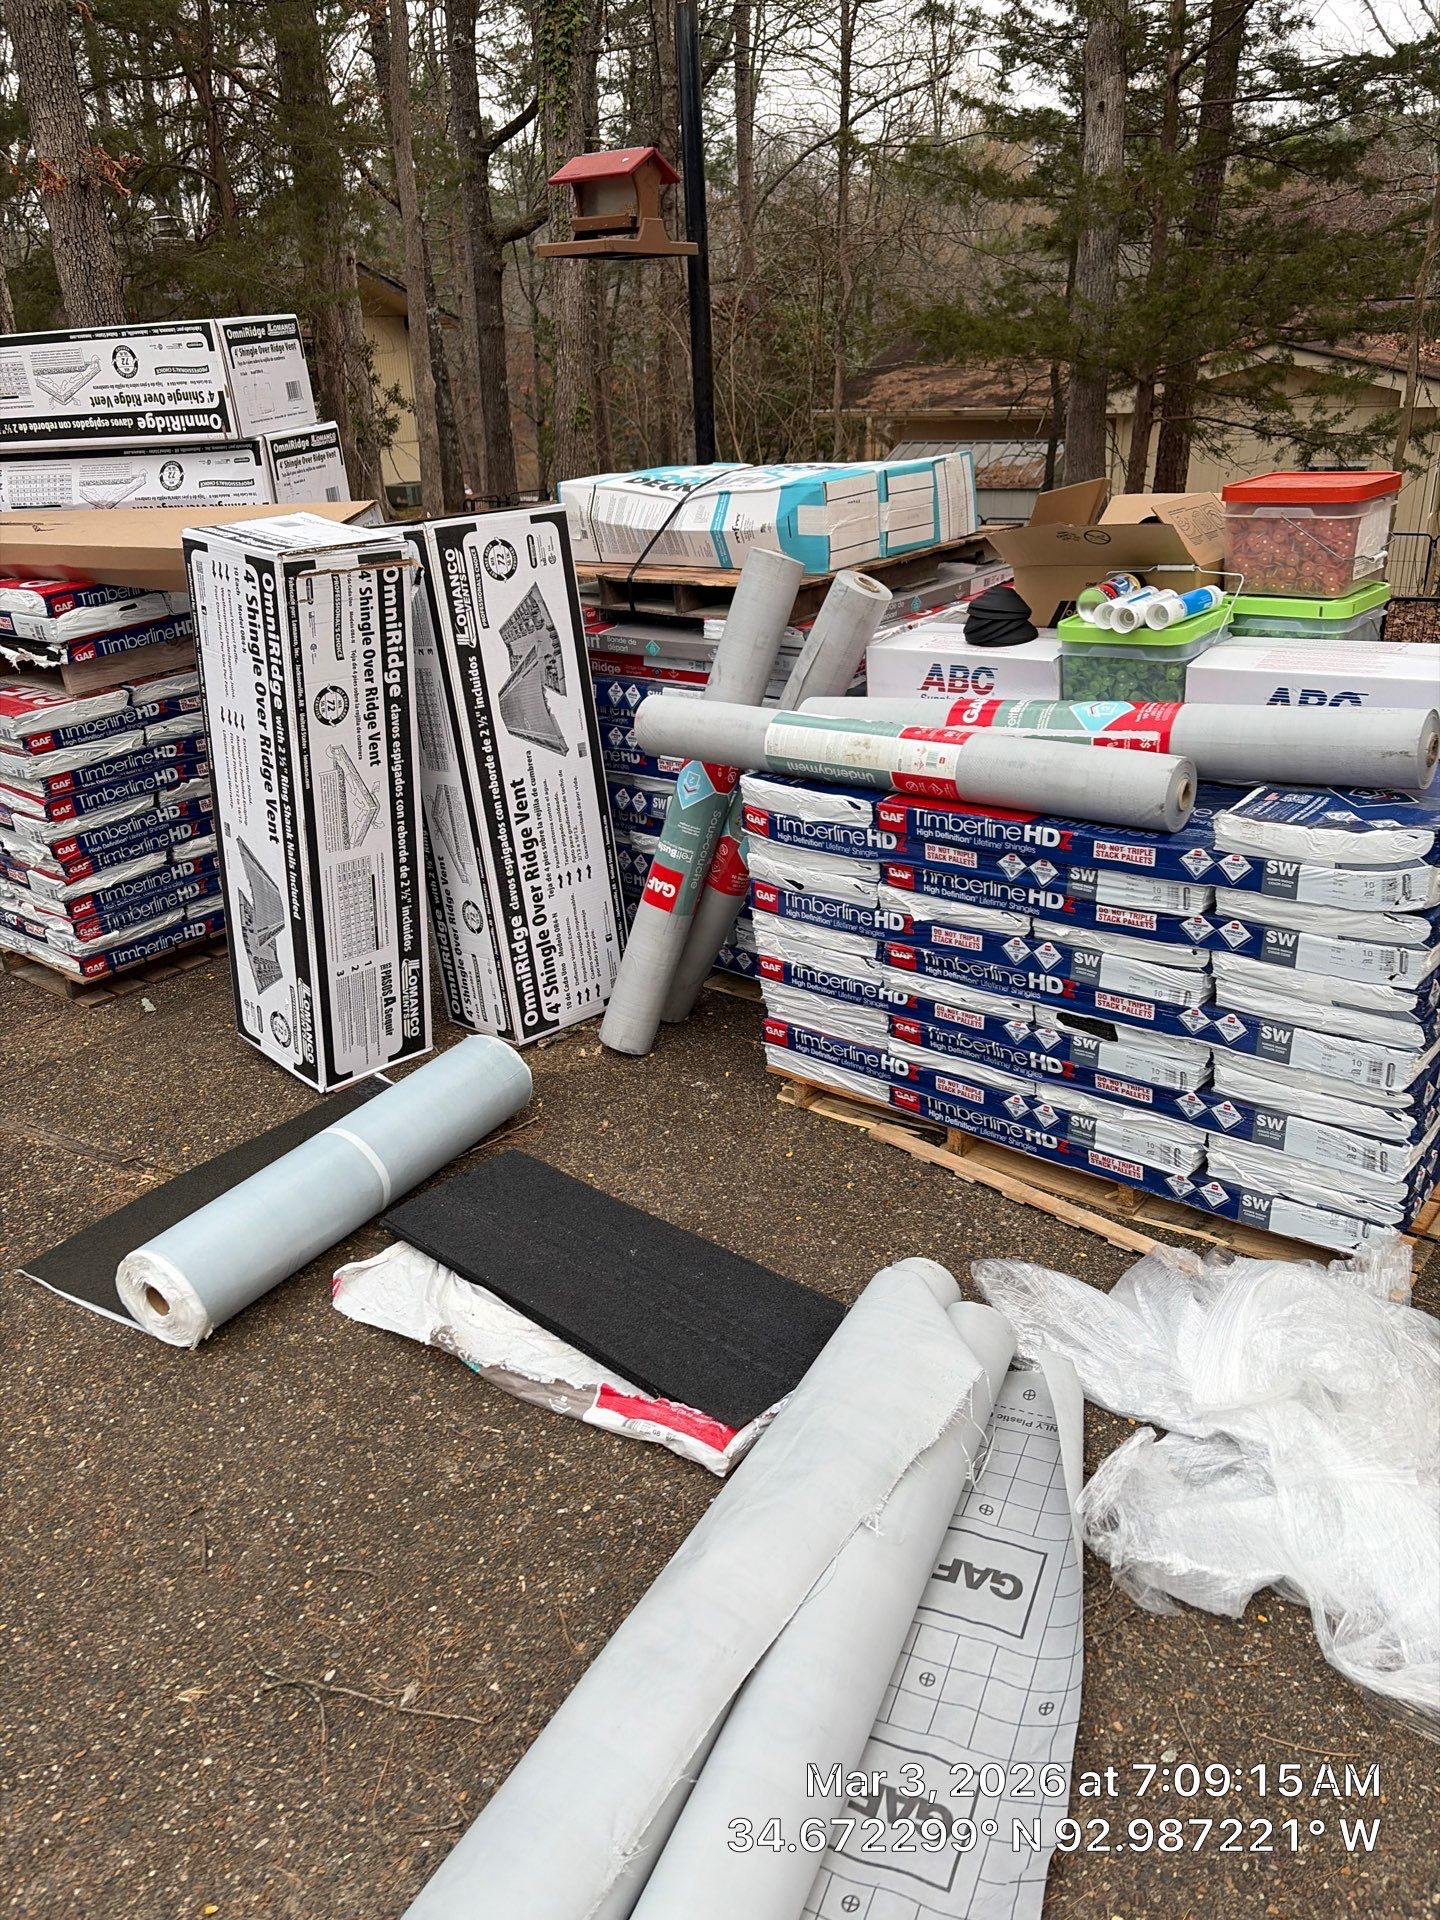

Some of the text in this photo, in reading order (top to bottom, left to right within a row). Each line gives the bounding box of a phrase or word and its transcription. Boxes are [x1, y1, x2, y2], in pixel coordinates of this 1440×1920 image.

[227, 323, 296, 339] OmniRidge LOMANCO
[120, 356, 129, 365] 72
[240, 346, 258, 358] Shingle
[258, 346, 270, 354] Over
[270, 344, 285, 354] Ridge
[286, 342, 296, 350] Vent
[89, 394, 113, 408] Vent
[114, 390, 143, 407] Ridge
[145, 392, 165, 404] Over
[166, 388, 204, 404] Shingle
[136, 409, 222, 432] OmniRidge
[274, 433, 336, 453] OmniRidge LOMANCO
[496, 553, 505, 565] 72
[440, 547, 470, 646] LOMANCO
[458, 573, 472, 612] VENTS
[468, 547, 489, 626] PROFESSIONAL'S CHOICE
[355, 586, 376, 646] Shingle
[75, 620, 193, 662] GAF Timberline HD
[243, 591, 265, 679] Shingle
[260, 570, 285, 712] OmniRidge
[379, 567, 405, 698] OmniRidge
[362, 649, 378, 683] Over
[592, 661, 620, 674] Ridge
[917, 664, 998, 696] ABC
[465, 655, 485, 709] incluidos
[1266, 688, 1369, 706] ABC
[253, 679, 269, 732] Over
[326, 698, 336, 712] 72
[362, 686, 380, 730] Ridge
[275, 713, 284, 744] with
[478, 727, 489, 736] 2
[277, 744, 284, 753] 2
[368, 731, 382, 767] Vent
[480, 737, 492, 753] de
[256, 731, 275, 795] Ridge
[389, 740, 405, 798] espigados
[483, 753, 501, 800] reborde
[524, 749, 537, 786] cumbrera
[787, 761, 876, 784] Underlayment
[279, 773, 290, 804] Ring
[508, 777, 530, 825] Vent
[530, 787, 538, 797] de
[395, 798, 404, 819] con
[492, 800, 504, 821] con
[532, 797, 543, 820] rejilla
[652, 798, 666, 810] SW
[58, 844, 77, 855] GAF
[80, 814, 157, 847] Timberline
[264, 794, 280, 846] Vent
[283, 802, 294, 842] Shank
[746, 814, 767, 826] GAF
[774, 814, 865, 847] Timberline
[880, 810, 904, 823] GAF
[913, 808, 1022, 841] Timberline
[396, 819, 409, 863] reborde
[495, 821, 516, 877] espigados
[515, 823, 544, 882] Ridge
[537, 829, 547, 850] sobre
[690, 810, 722, 889] Sous-couche
[916, 828, 934, 838] High
[1004, 842, 1036, 854] Shingles
[938, 846, 952, 854] NOT
[953, 848, 976, 858] TRIPLE
[1096, 842, 1154, 858] DO NOT TRIPLE
[286, 840, 296, 872] Nails
[541, 850, 550, 866] pies
[926, 851, 976, 866] STACK PALLETS
[1094, 848, 1153, 865] STACK PALLETS
[1266, 860, 1298, 878] SW
[399, 864, 410, 879] de
[400, 879, 410, 888] 2
[544, 871, 552, 882] de
[888, 868, 912, 880] GAF
[1070, 868, 1097, 884] SW
[289, 870, 301, 921] Included
[546, 882, 555, 898] Teja
[647, 876, 676, 898] GAF
[526, 883, 548, 927] Over
[756, 890, 776, 902] GAF
[784, 890, 872, 926] Timberline
[401, 904, 413, 952] incluidos
[87, 962, 104, 974] GAF
[110, 932, 184, 965] Timberline
[554, 932, 564, 956] Modelo
[505, 913, 543, 1028] OmniRidge
[533, 927, 562, 998] Shingle
[1073, 952, 1100, 968] SW
[380, 968, 393, 997] PASOS
[406, 956, 421, 1038] LOMANCO
[559, 962, 572, 1009] 10 de Cada Uno
[383, 994, 396, 1008] A
[401, 988, 410, 1020] VENTS
[301, 980, 316, 1067] LOMANCO
[1262, 1025, 1292, 1044] SW
[766, 1026, 786, 1038] GAF
[792, 1028, 878, 1067] Timberline
[1256, 1115, 1285, 1131] SW
[996, 1412, 1058, 1434] NLY Plastic
[931, 1558, 1023, 1601] GAF
